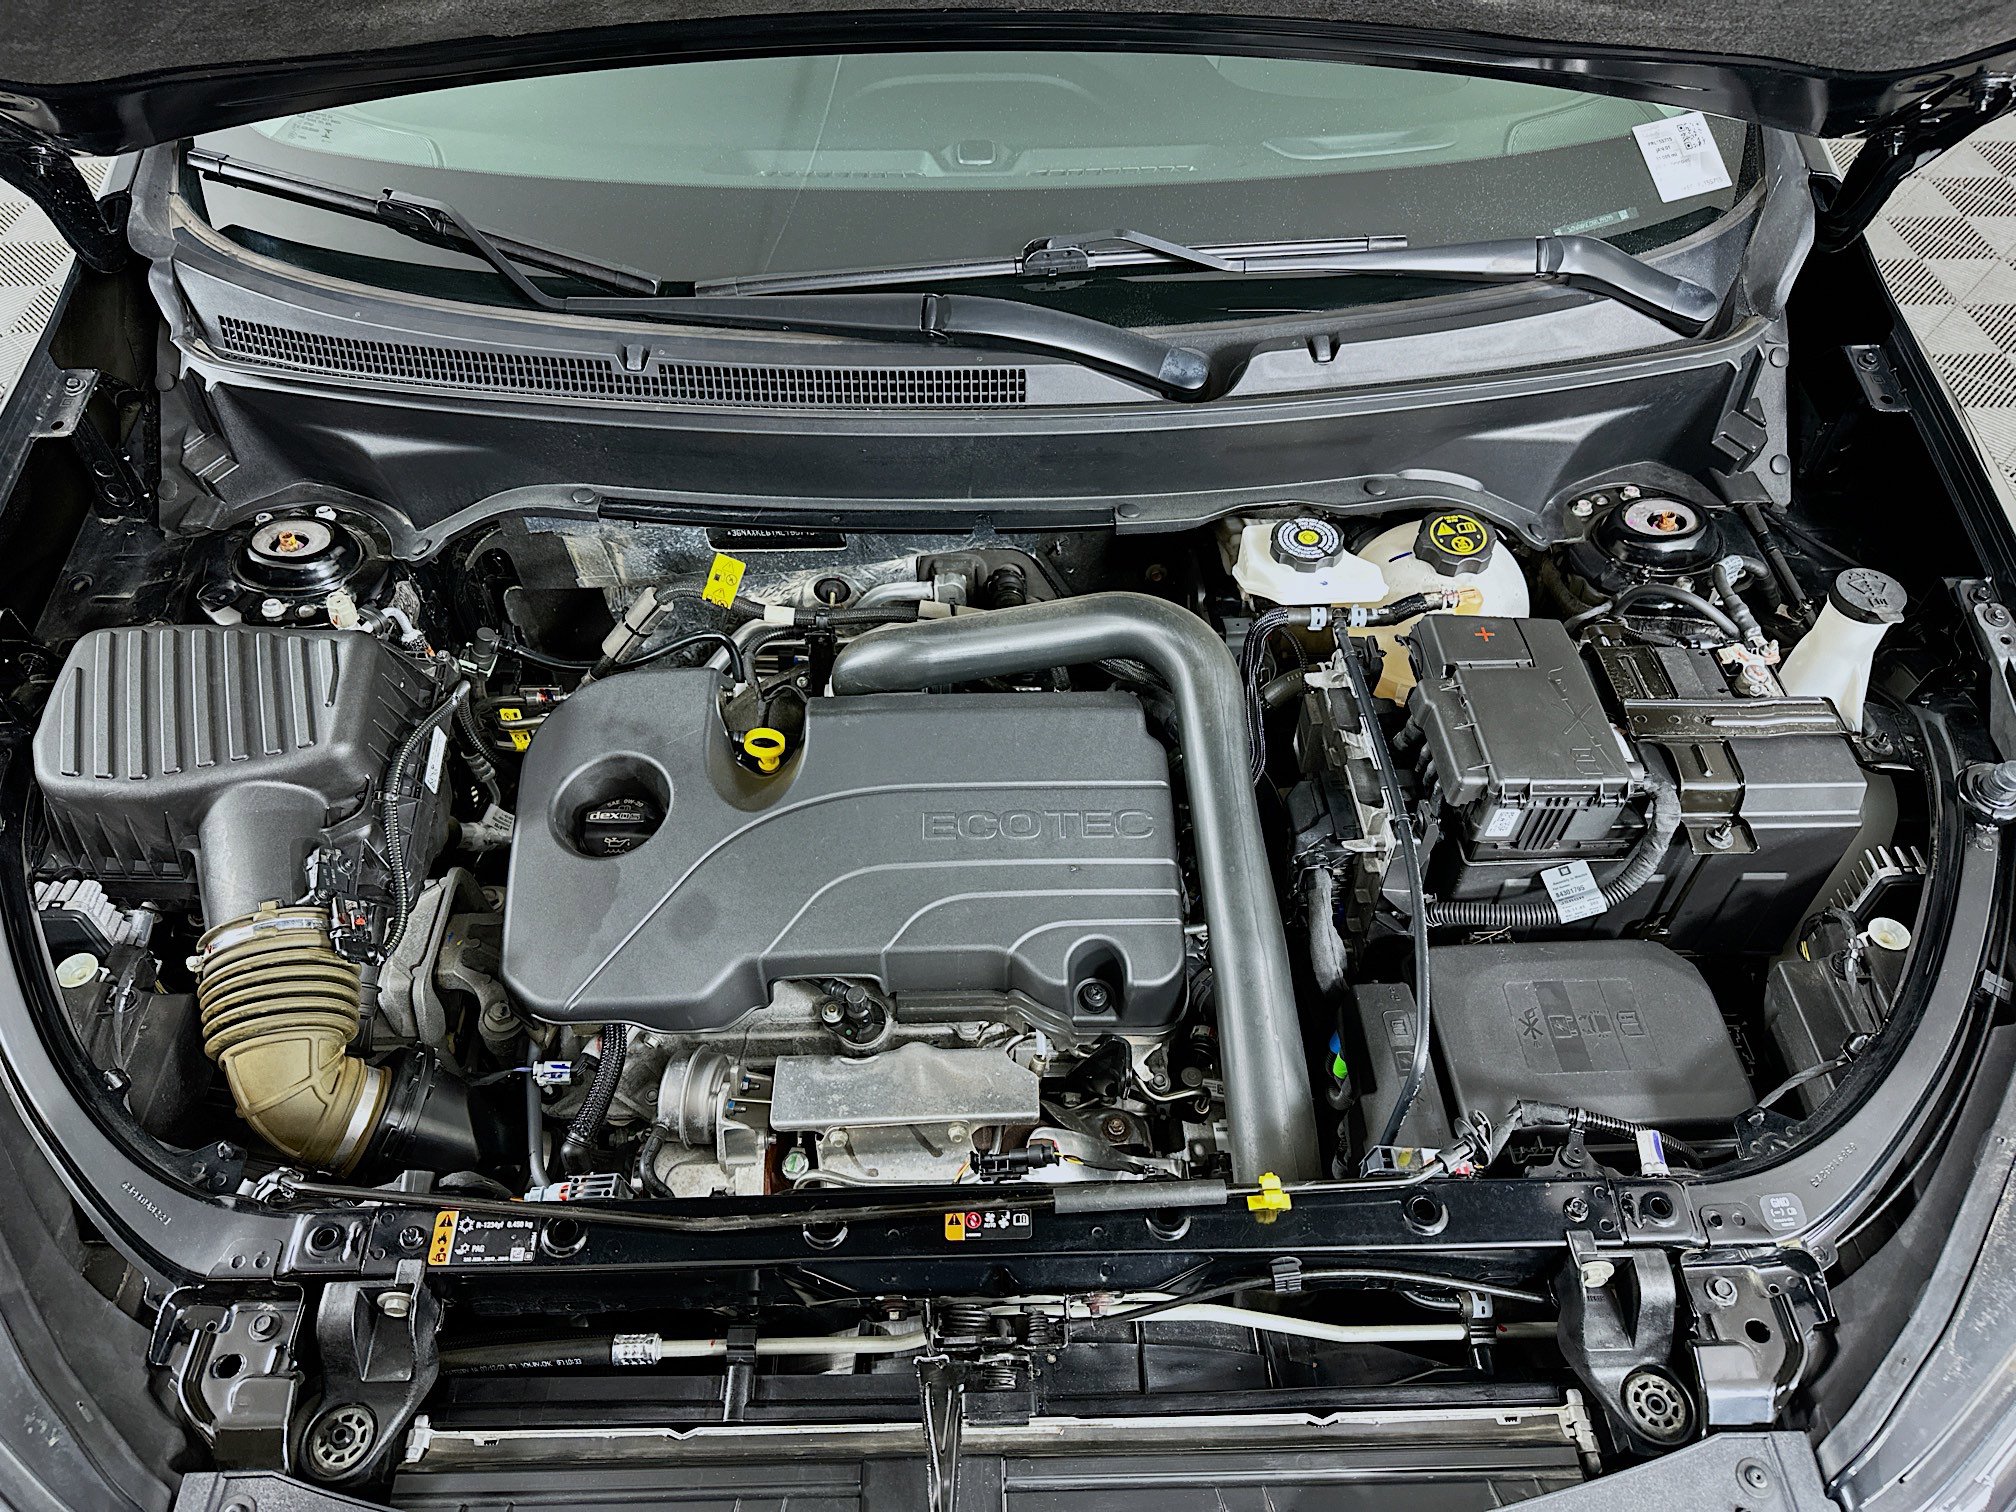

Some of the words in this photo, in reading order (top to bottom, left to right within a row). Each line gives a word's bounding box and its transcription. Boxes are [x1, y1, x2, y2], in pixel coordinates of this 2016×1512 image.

[589, 811, 641, 820] dexos
[922, 809, 1155, 840] ECOTEC
[476, 1220, 504, 1230] R-1234yf
[525, 1220, 533, 1229] kg
[471, 1244, 485, 1253] PAG
